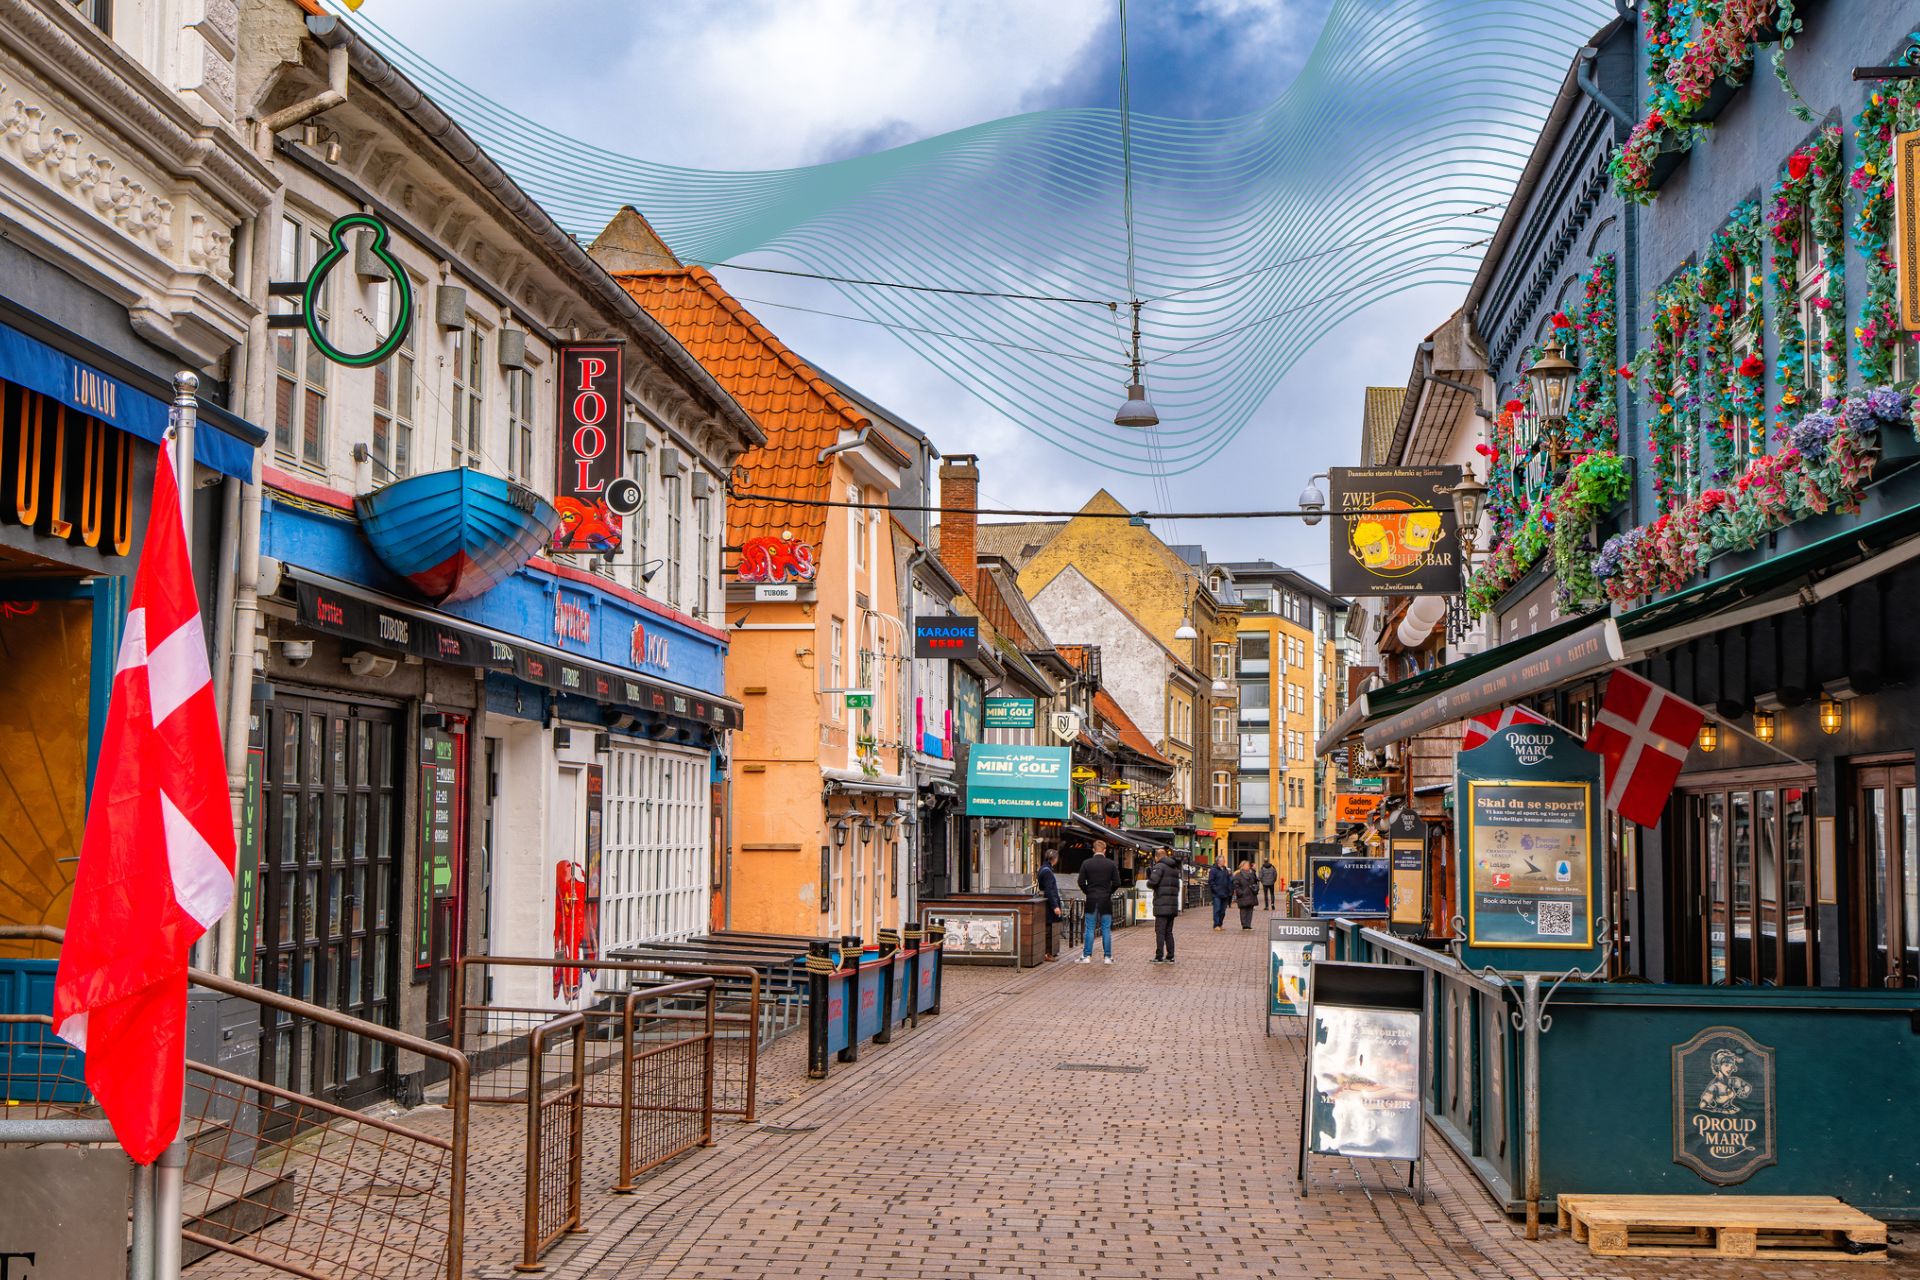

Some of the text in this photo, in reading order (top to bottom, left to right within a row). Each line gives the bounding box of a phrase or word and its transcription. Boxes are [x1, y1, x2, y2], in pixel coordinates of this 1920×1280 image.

[74, 365, 115, 418] LOULOU
[573, 357, 607, 492] POOL
[626, 489, 636, 502] 8
[1343, 492, 1375, 506] ZWEI
[1343, 507, 1396, 521] GROSSE
[1394, 553, 1452, 566] BIER BAR
[379, 613, 408, 644] TUBORG
[917, 627, 975, 637] KARAOKE
[986, 708, 1033, 717] MINI GOLF
[1505, 732, 1554, 749] PROUD
[1515, 745, 1548, 756] MARY
[976, 761, 1060, 773] MINI GOLF
[972, 798, 996, 806] DRINKS,
[1348, 797, 1372, 805] Gadens
[1478, 798, 1505, 808] Skal
[1508, 799, 1524, 808] du
[1545, 801, 1584, 810] sport?
[239, 763, 255, 975] LIVE MUSIK
[421, 861, 430, 946] MUSIK
[1278, 925, 1320, 936] TUBORG
[1692, 1114, 1757, 1137] PROUD
[1705, 1133, 1750, 1147] MARY
[1714, 1146, 1736, 1154] PUB
